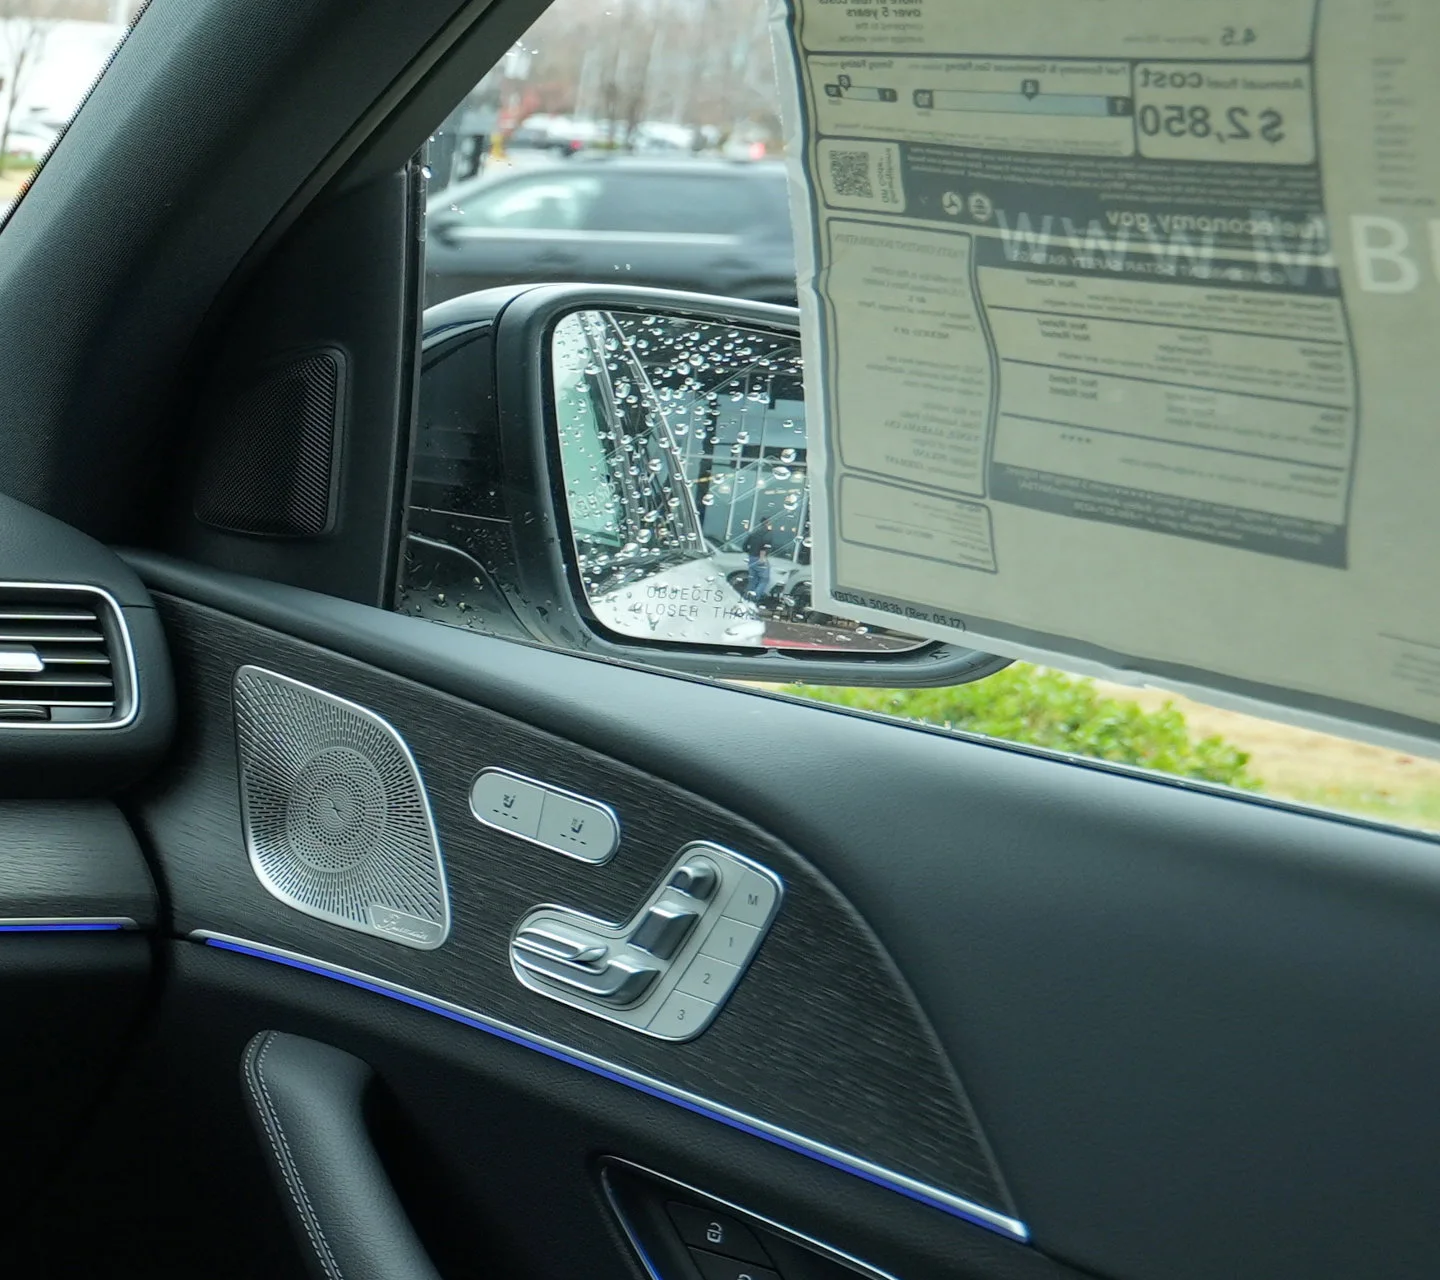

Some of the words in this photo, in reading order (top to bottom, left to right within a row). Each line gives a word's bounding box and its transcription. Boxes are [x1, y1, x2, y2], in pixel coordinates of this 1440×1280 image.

[646, 584, 724, 603] OBJECTS
[747, 894, 758, 905] M
[729, 937, 733, 947] 1
[703, 973, 711, 984] 2
[677, 1009, 685, 1020] 3
